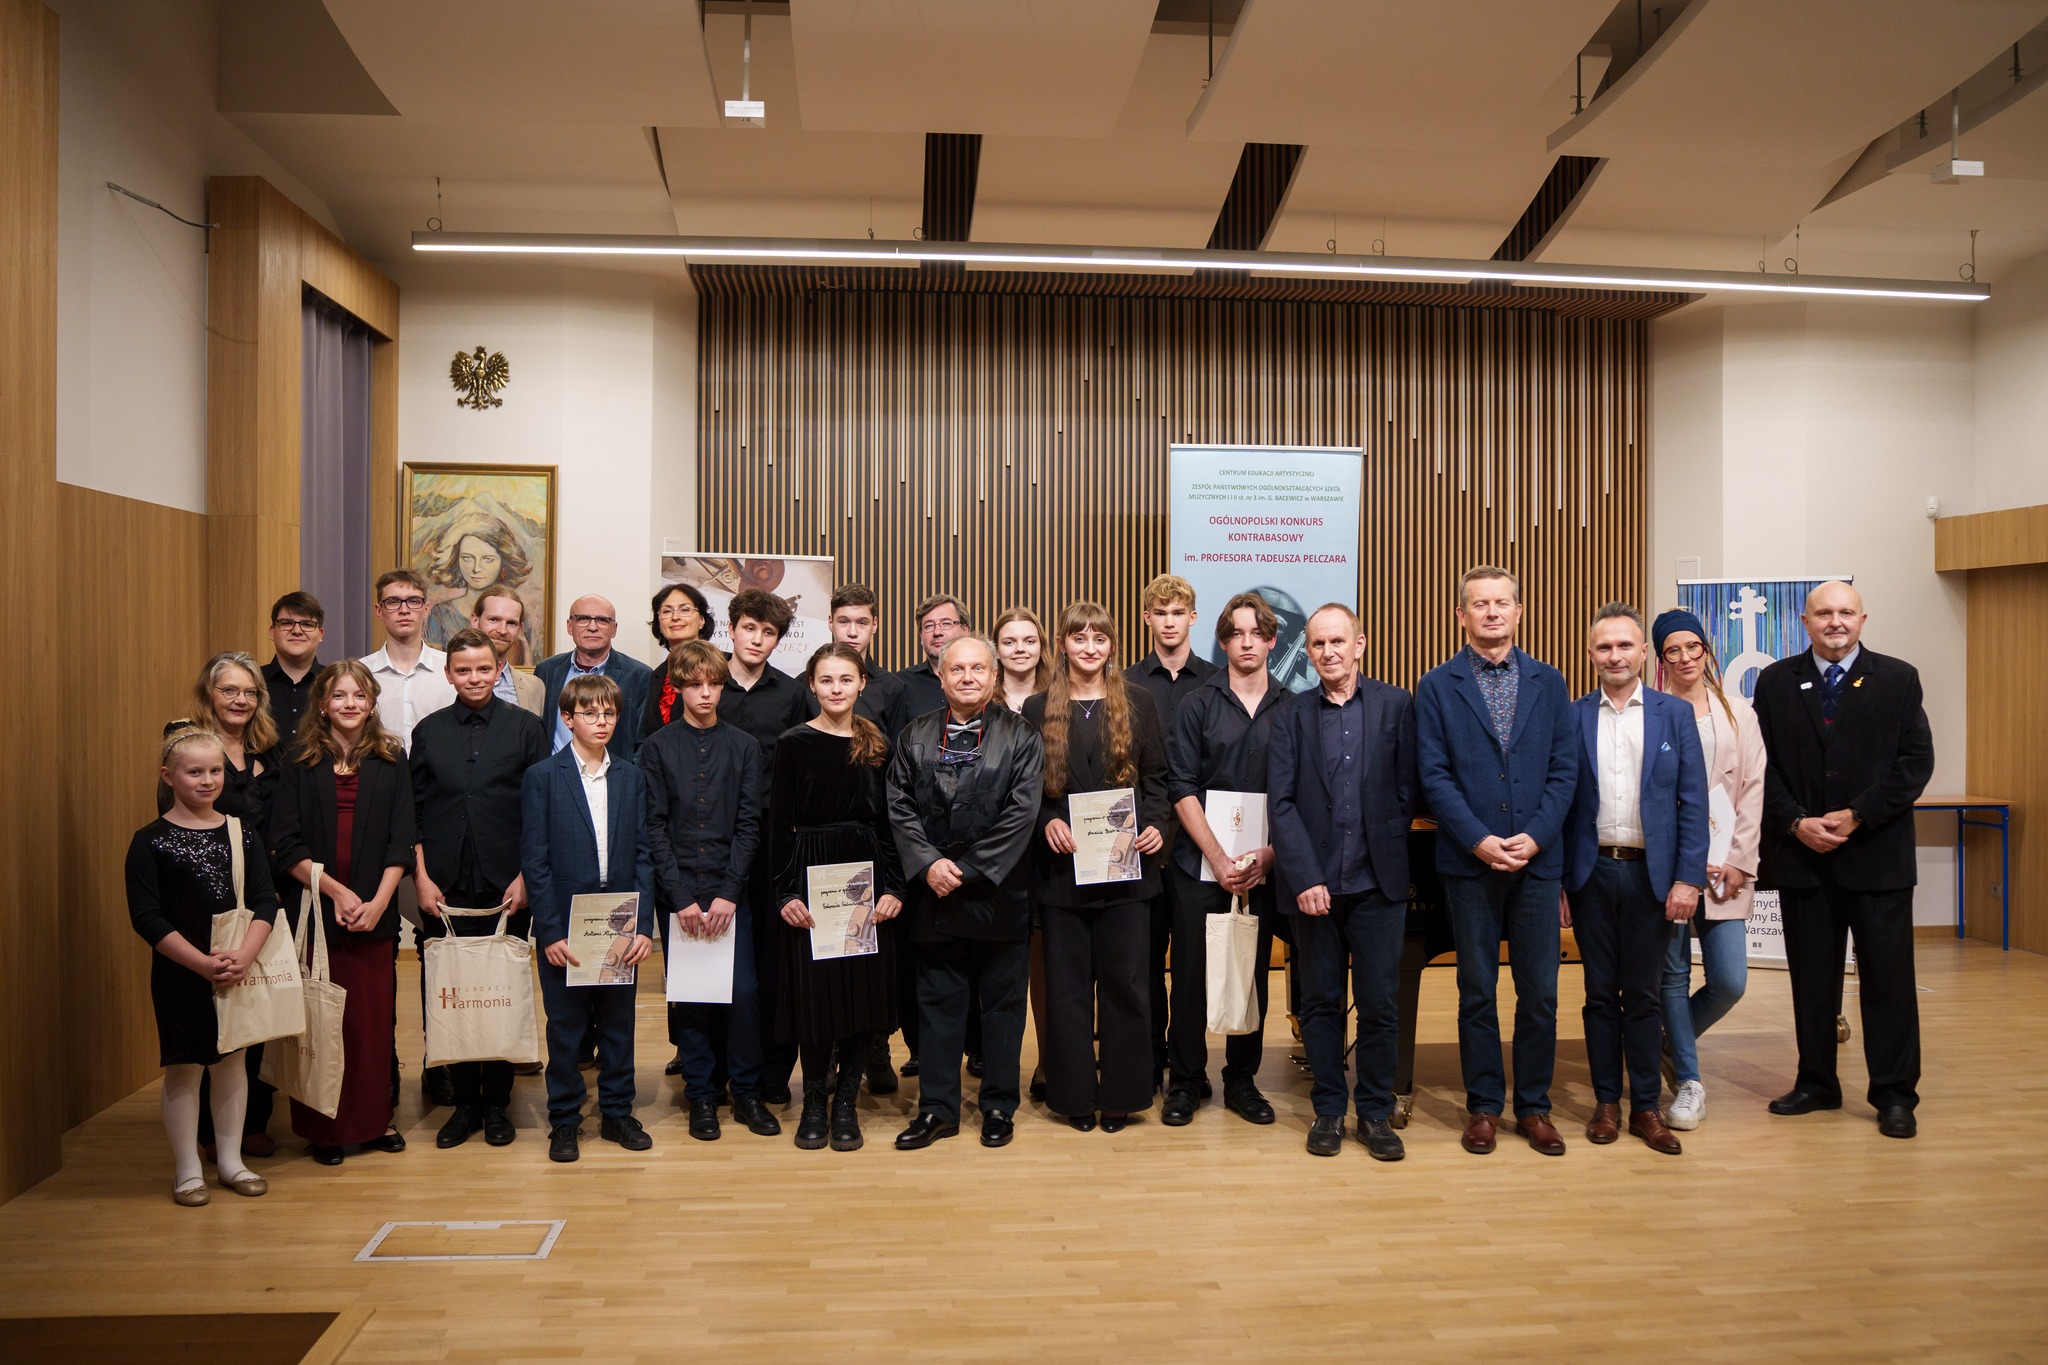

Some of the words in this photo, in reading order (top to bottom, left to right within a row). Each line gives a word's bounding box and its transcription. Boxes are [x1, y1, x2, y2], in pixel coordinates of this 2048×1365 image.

[1209, 515, 1277, 525] OGÓLNOPOLSKI
[1281, 517, 1323, 526] KONKURS
[1228, 533, 1304, 542] KONTRABASOWY
[1184, 553, 1198, 562] im.
[1201, 554, 1252, 562] PROFESORA
[1255, 554, 1300, 562] TADEUSZA
[1304, 554, 1346, 563] PELCZARA
[439, 988, 511, 1009] Harmonia
